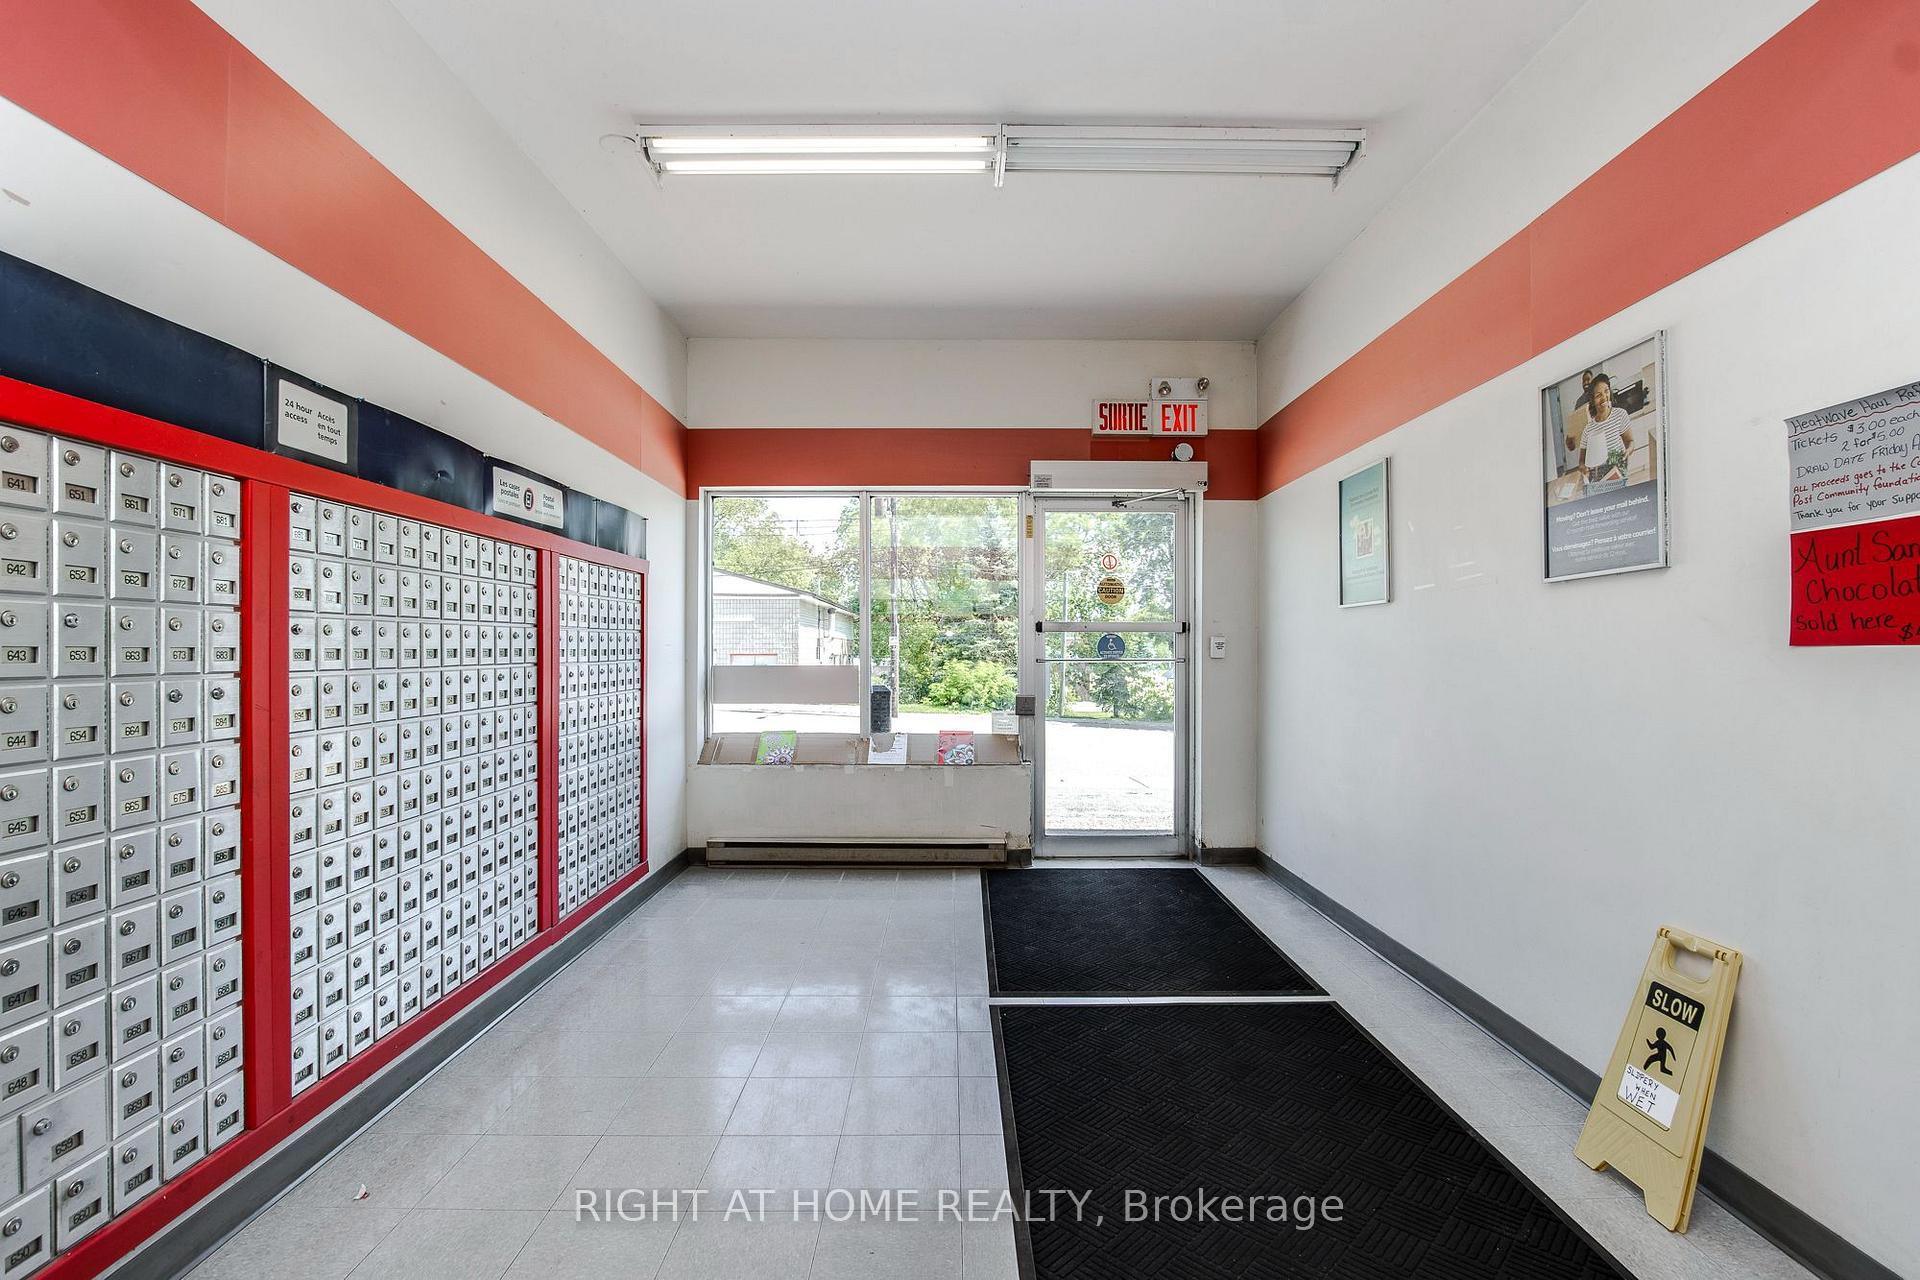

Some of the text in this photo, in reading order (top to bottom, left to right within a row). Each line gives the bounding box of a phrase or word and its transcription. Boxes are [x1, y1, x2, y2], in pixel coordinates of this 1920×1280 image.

[284, 398, 313, 416] 24 hour
[284, 411, 308, 424] access
[1099, 403, 1148, 431] SORTIE
[1161, 404, 1198, 432] EXIT
[1889, 410, 1920, 425] each
[317, 423, 341, 436] en tout
[317, 432, 338, 446] temps
[1841, 441, 1850, 452] 2
[1796, 462, 1830, 479] DRAW
[1833, 452, 1867, 469] DATE
[1811, 474, 1850, 491] proceeds
[1854, 470, 1874, 485] goes
[1876, 464, 1886, 475] to
[1889, 462, 1906, 473] the
[7, 478, 26, 490] 641
[69, 489, 86, 500] 651
[1793, 494, 1813, 508] Post
[1816, 483, 1869, 501] Community
[124, 499, 139, 510] 661
[1576, 510, 1590, 519] Don't
[1603, 505, 1616, 514] your
[1616, 501, 1628, 509] mail
[1793, 509, 1824, 521] Thank
[1825, 507, 1843, 518] you
[1847, 501, 1861, 512] for
[1866, 498, 1887, 512] your
[173, 507, 186, 518] 671
[1794, 531, 1869, 574] Aunt
[6, 563, 26, 576] 642
[69, 570, 86, 581] 652
[124, 575, 140, 586] 662
[172, 579, 186, 590] 672
[215, 584, 228, 593] 682
[1850, 611, 1898, 630] here
[7, 650, 26, 661] 643
[69, 650, 87, 661] 653
[125, 650, 140, 661] 663
[173, 650, 186, 660] 673
[215, 650, 228, 660] 683
[173, 721, 186, 732] 674
[215, 717, 228, 727] 684
[70, 730, 87, 741] 654
[125, 725, 140, 736] 664
[7, 736, 26, 747] 644
[173, 792, 187, 803] 675
[125, 801, 140, 812] 665
[69, 810, 87, 822] 655
[8, 821, 27, 834] 645
[215, 850, 228, 862] 686
[173, 862, 187, 874] 676
[70, 890, 87, 903] 656
[8, 907, 27, 920] 646
[216, 916, 229, 929] 687
[173, 932, 188, 945] 677
[125, 950, 141, 964] 667
[70, 969, 87, 984] 657
[8, 991, 27, 1007] 647
[175, 1004, 188, 1016] 678
[1652, 989, 1698, 1024] SLOW
[126, 1024, 142, 1038] 668
[70, 1049, 88, 1064] 658
[217, 1051, 230, 1064] 689
[8, 1077, 27, 1093] 648
[175, 1073, 189, 1088] 679
[1635, 1083, 1657, 1100] WHEN
[1625, 1085, 1656, 1113] WET
[176, 1143, 190, 1158] 680
[128, 1174, 143, 1189] 670
